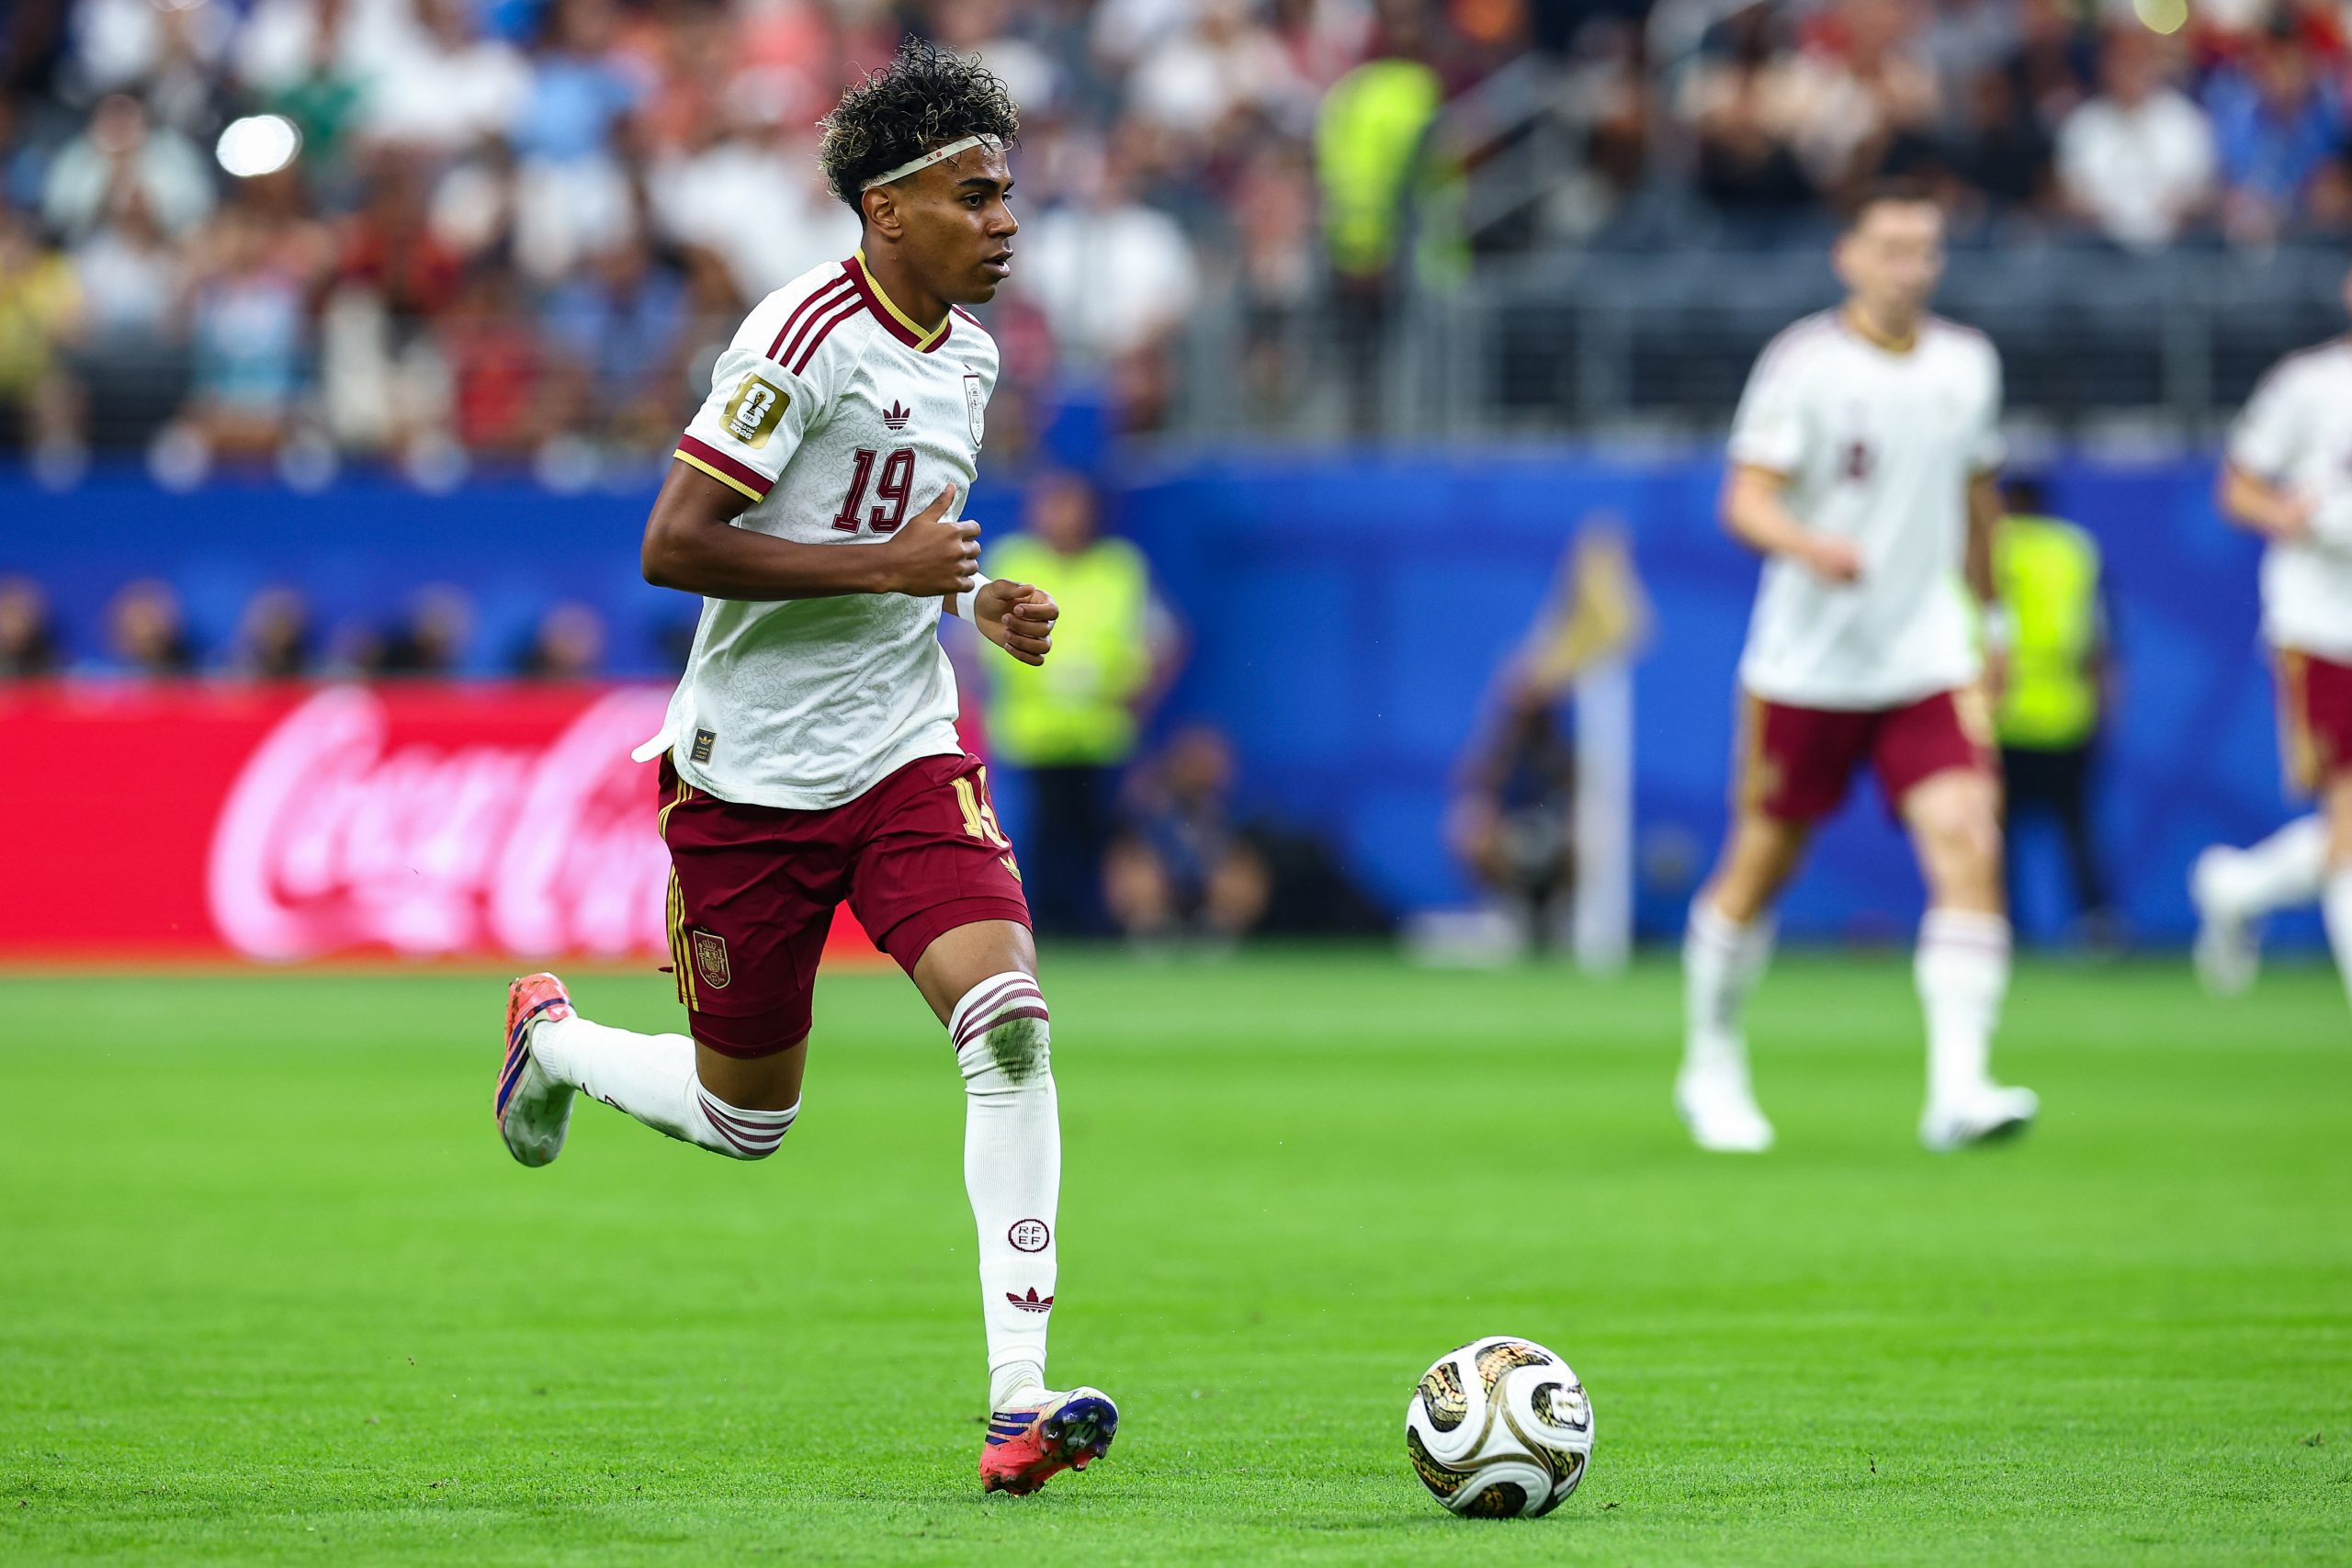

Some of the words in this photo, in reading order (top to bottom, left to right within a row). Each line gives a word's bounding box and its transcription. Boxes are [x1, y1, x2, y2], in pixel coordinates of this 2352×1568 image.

[742, 413, 753, 423] FIFA
[732, 419, 746, 429] WORLD
[729, 423, 753, 440] 2026
[831, 446, 916, 534] 19
[1019, 1226, 1041, 1235] RF
[1019, 1235, 1041, 1245] EF
